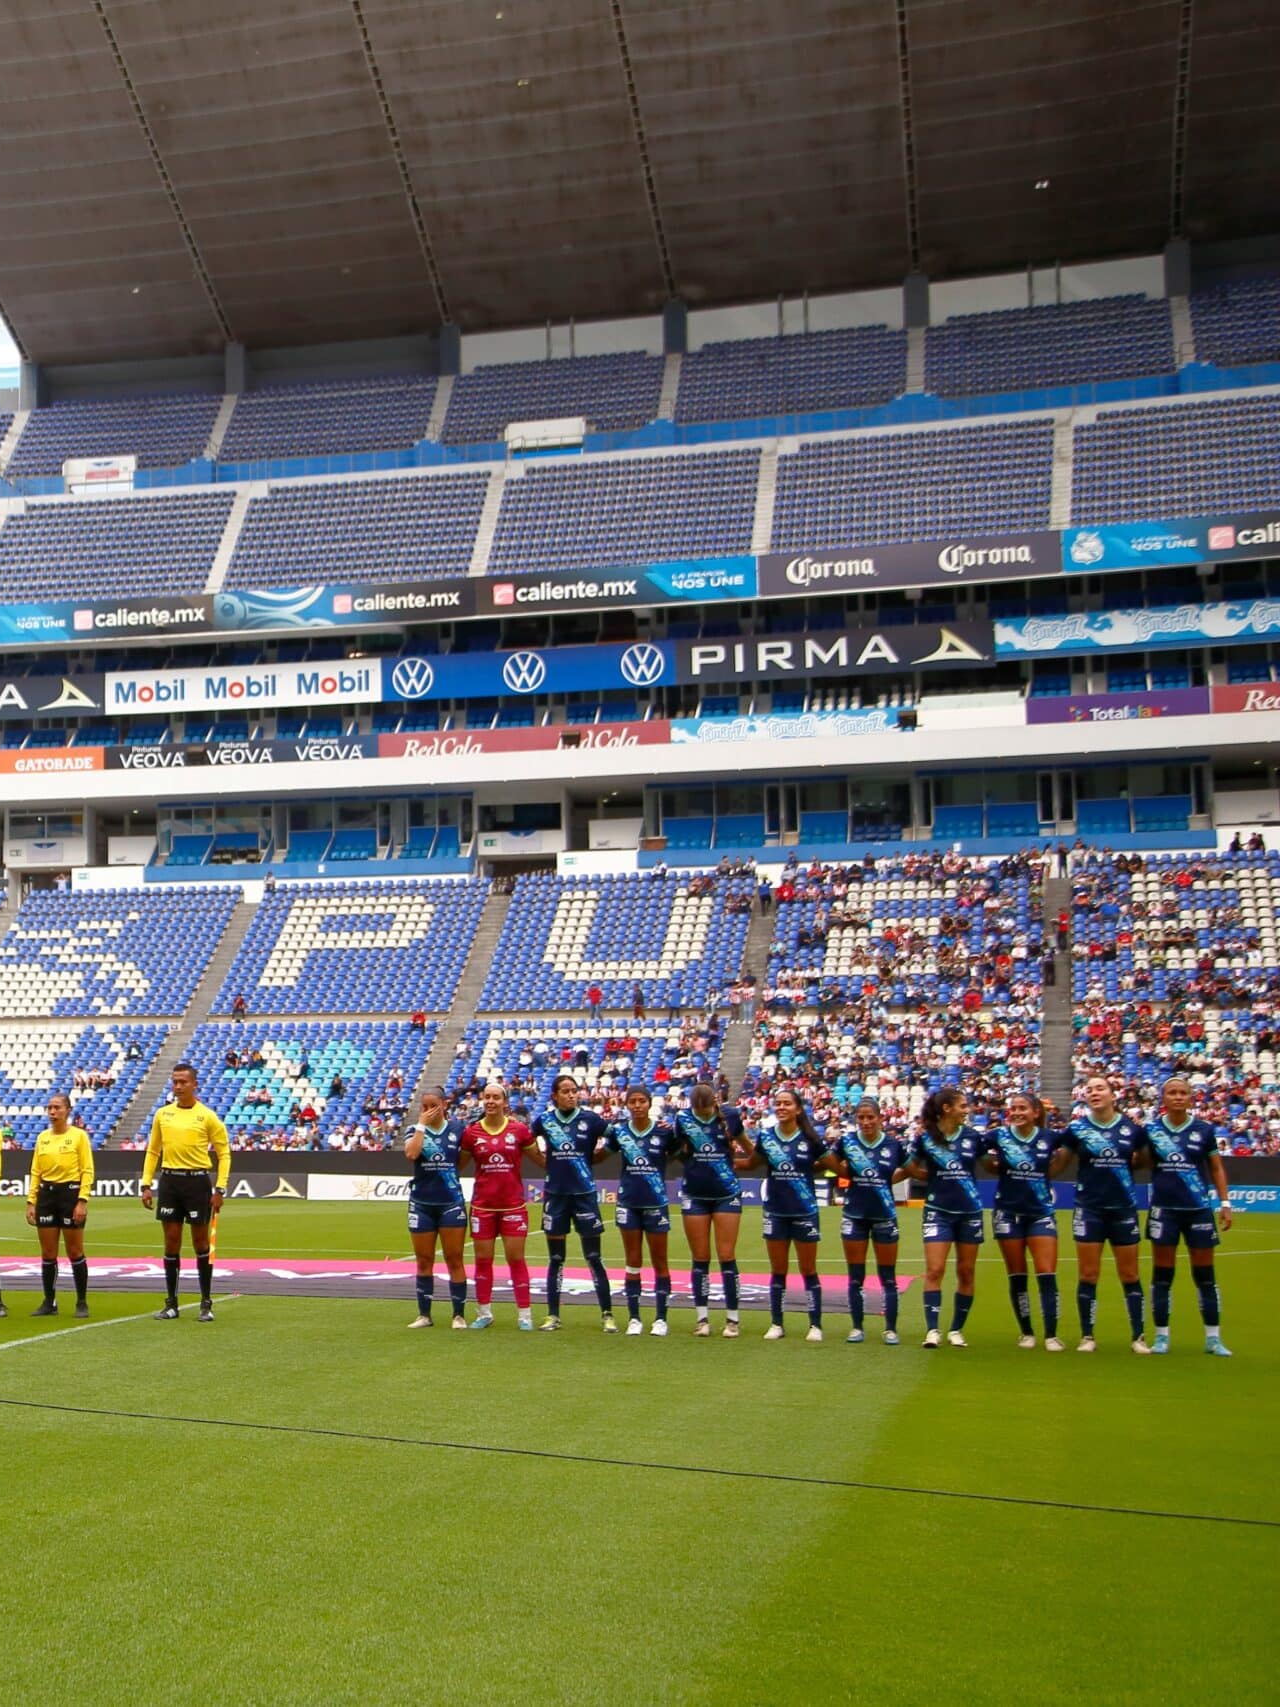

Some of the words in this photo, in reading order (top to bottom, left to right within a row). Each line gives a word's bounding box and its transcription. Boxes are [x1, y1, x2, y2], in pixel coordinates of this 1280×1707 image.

[938, 544, 1032, 574] Corona
[672, 578, 705, 590] NOS
[710, 574, 745, 588] UNE
[785, 556, 875, 586] Corona
[353, 590, 460, 613] caliente.mx
[516, 578, 637, 603] caliente.mx
[95, 606, 205, 628] caliente.mx
[691, 636, 900, 676] PIRMA
[115, 679, 185, 704] Mobil
[205, 675, 276, 699] Mobil
[297, 669, 370, 695] Mobil
[219, 742, 250, 750] Pinturas
[295, 744, 363, 761] VEOVA
[308, 738, 339, 746] Pinturas
[15, 757, 94, 772] GATORADE
[120, 751, 185, 768] VEOVA
[206, 748, 273, 765] VEOVA
[374, 1180, 410, 1197] Carl
